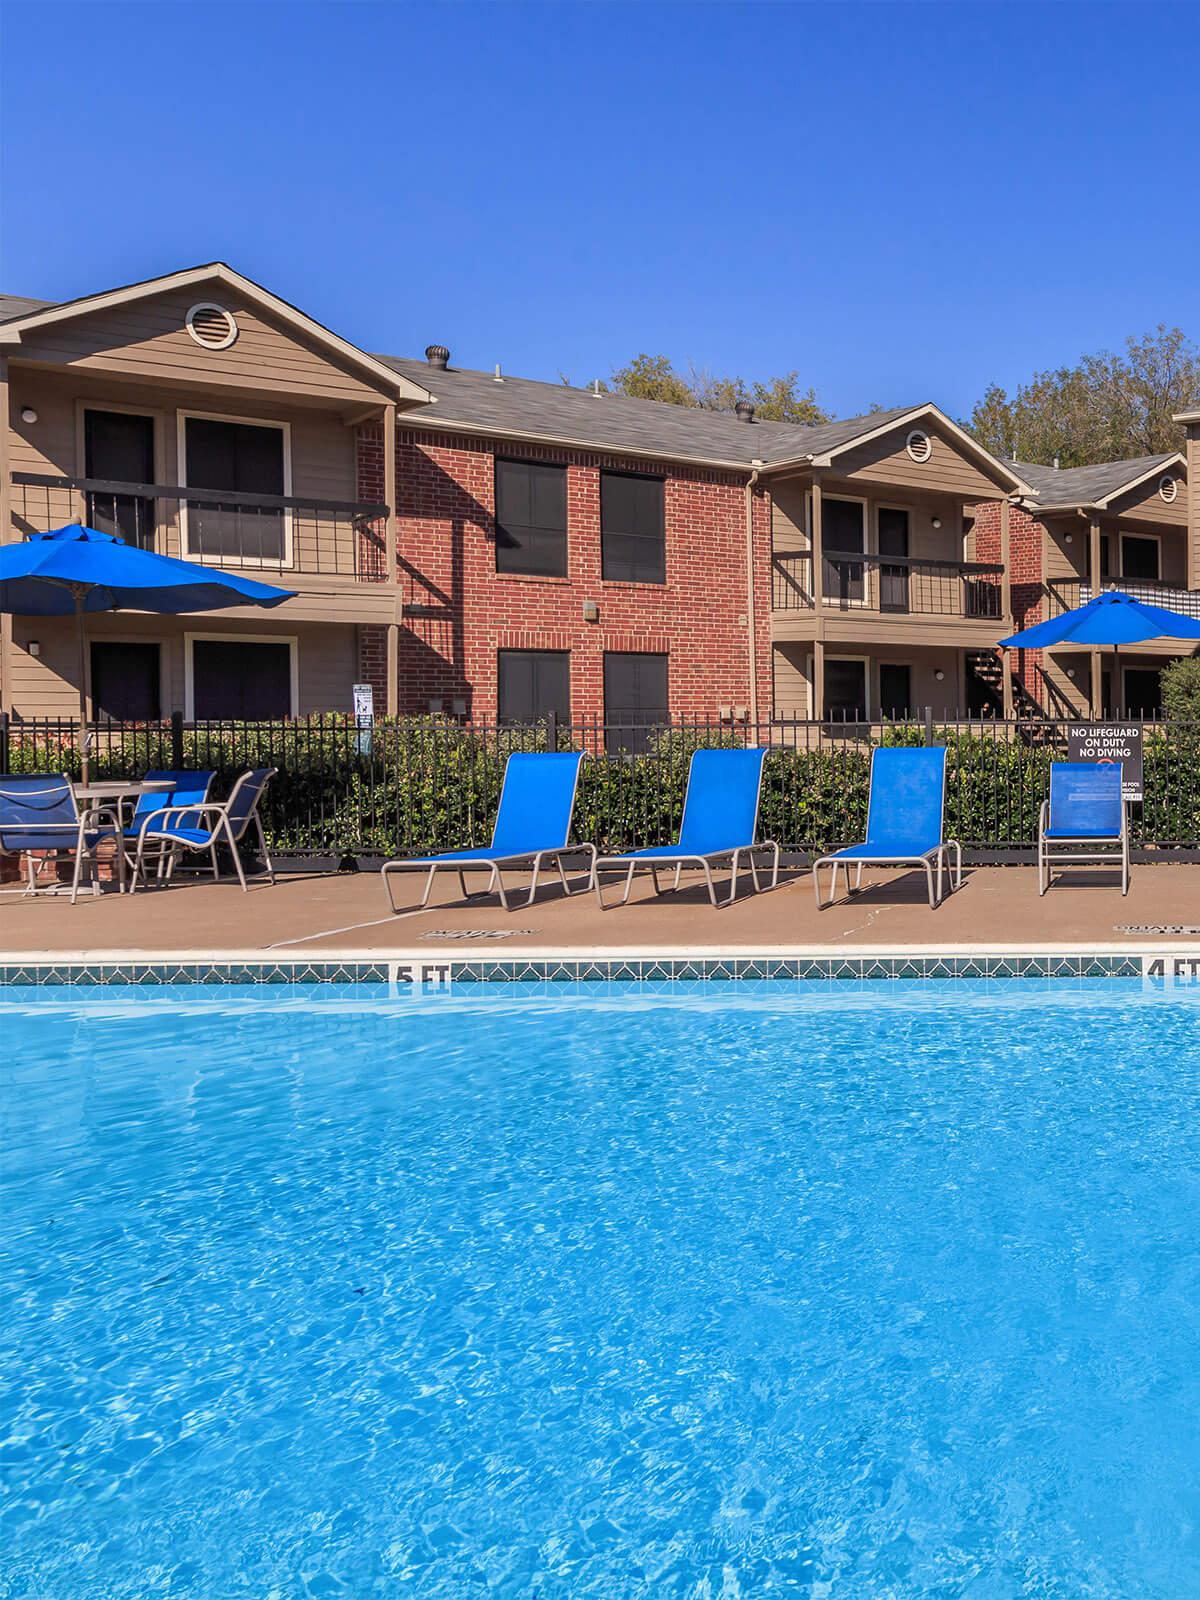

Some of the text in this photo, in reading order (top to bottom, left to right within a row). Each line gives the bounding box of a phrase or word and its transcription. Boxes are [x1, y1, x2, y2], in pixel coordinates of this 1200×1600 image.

[1071, 728, 1139, 737] NO LIFEGUARD
[1085, 738, 1126, 747] ON DUTY
[1080, 748, 1131, 757] NO DIVING
[1147, 958, 1200, 976] 4 FT
[397, 965, 449, 982] 5 FT
